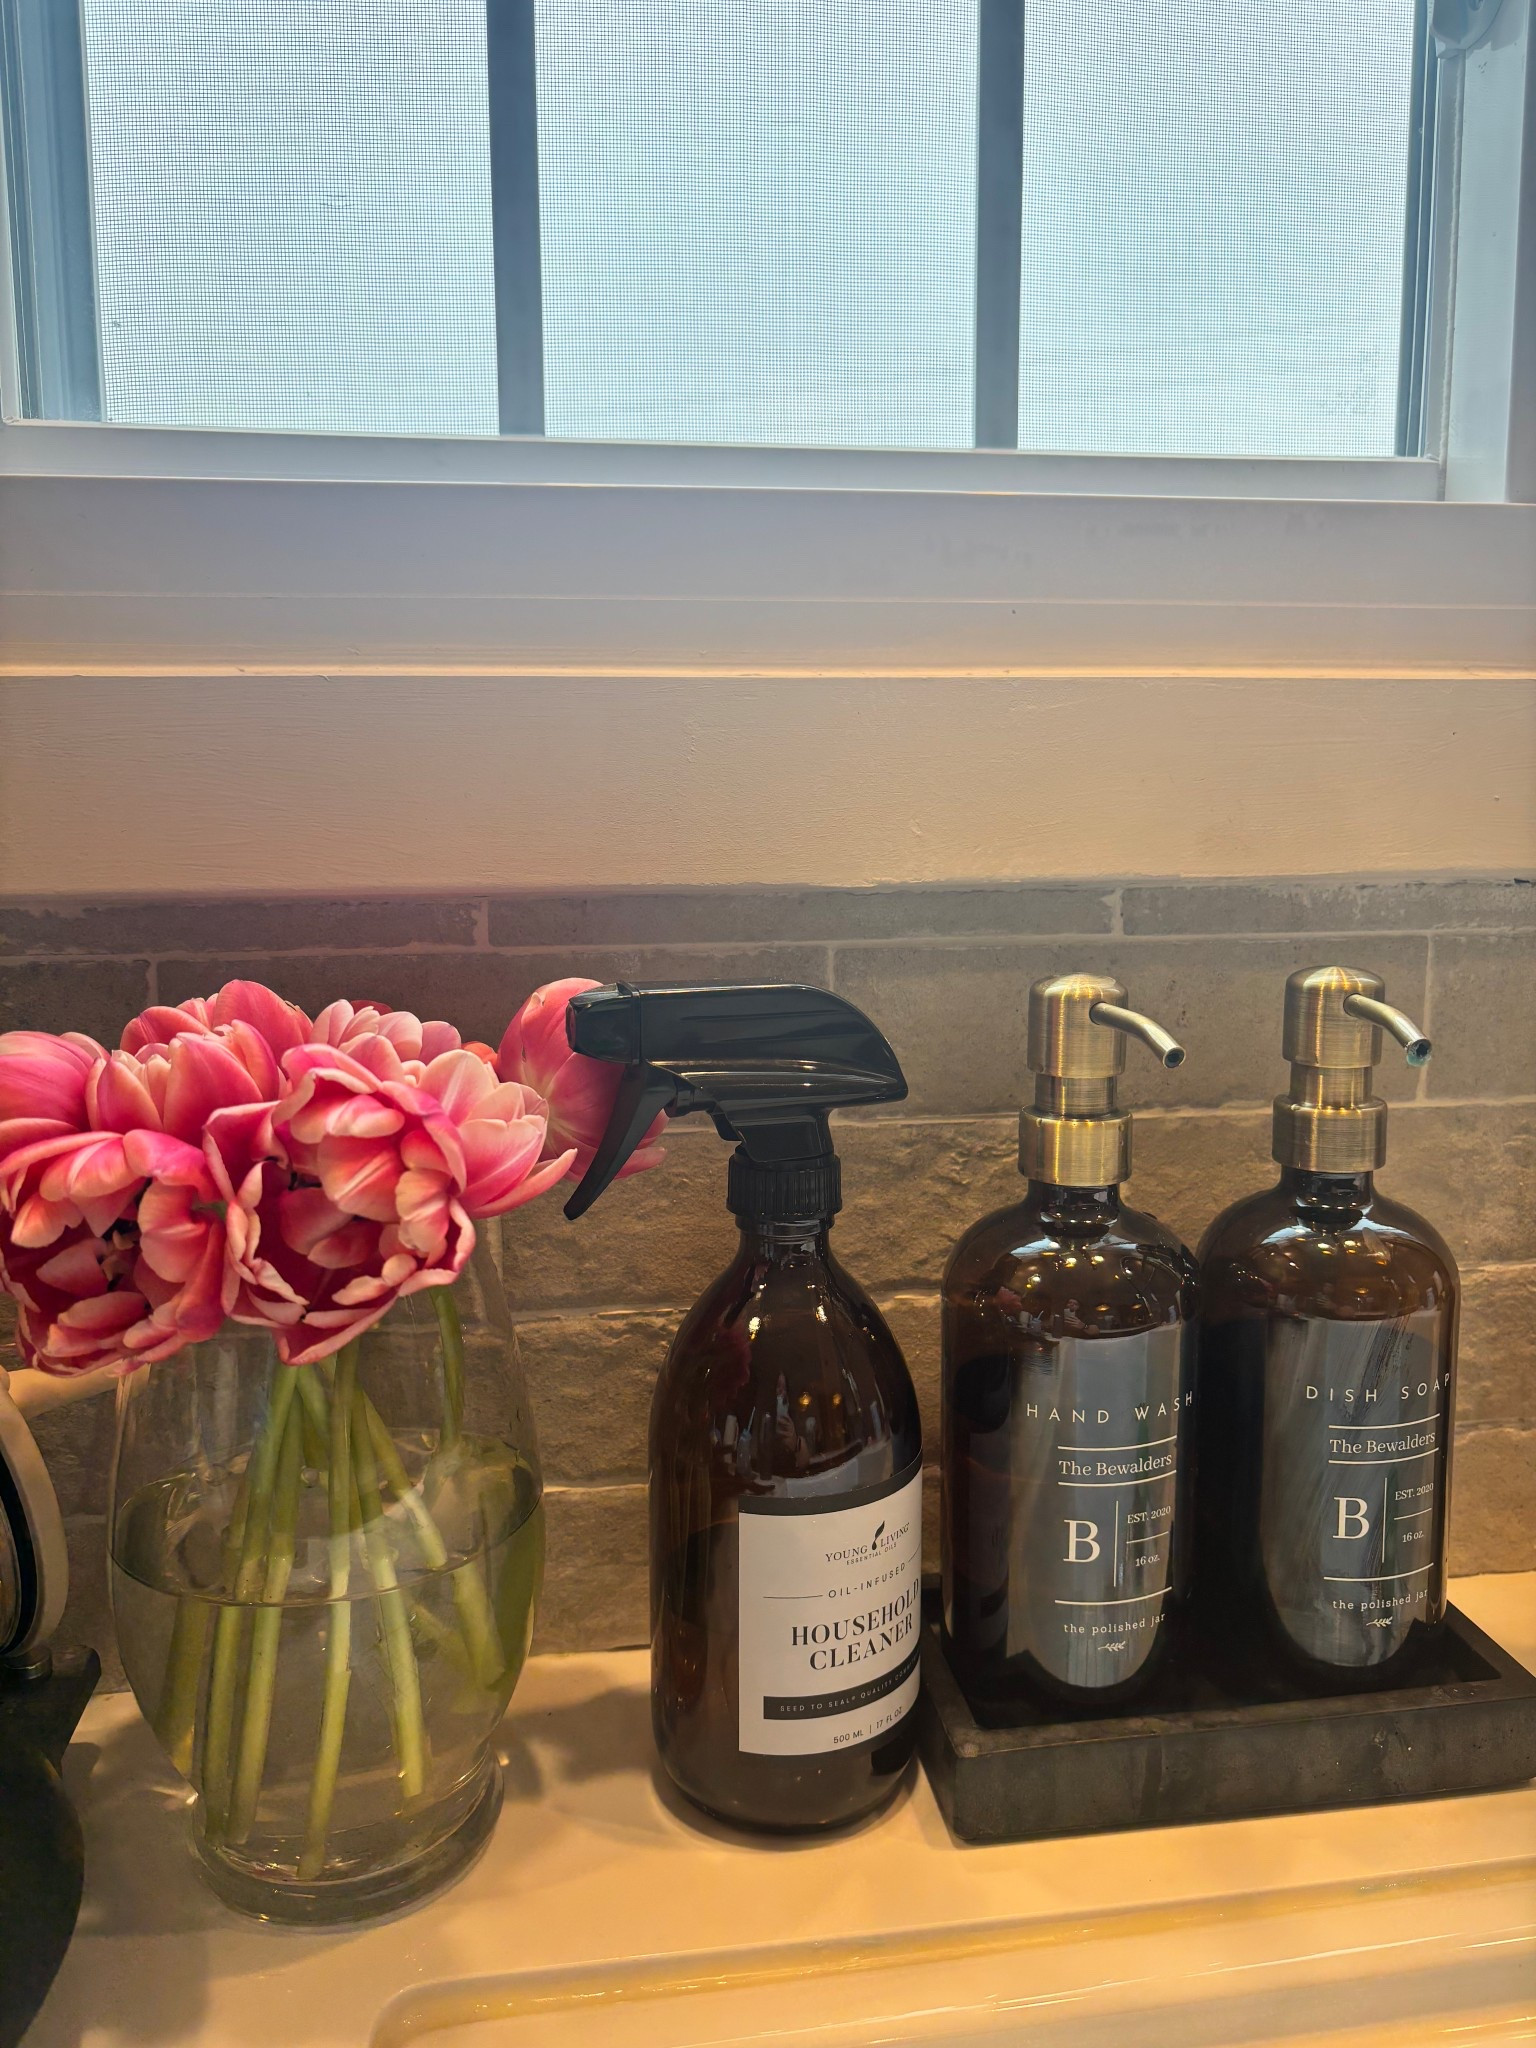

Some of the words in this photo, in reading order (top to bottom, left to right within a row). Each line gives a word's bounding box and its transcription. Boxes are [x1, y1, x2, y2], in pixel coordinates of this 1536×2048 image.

[1306, 1385, 1377, 1402] DISH
[1401, 1373, 1450, 1400] SOAP
[1026, 1403, 1110, 1424] HAND
[1134, 1391, 1193, 1421] WASH
[1329, 1438, 1362, 1454] The
[1365, 1430, 1436, 1454] Bewalders
[1058, 1460, 1092, 1476] The
[1095, 1454, 1173, 1476] Bewalders
[1394, 1489, 1416, 1501] EST.
[1416, 1482, 1434, 1497] 2020
[1127, 1513, 1150, 1525] EST.
[1150, 1504, 1171, 1521] 2020
[1332, 1496, 1370, 1540] B
[1062, 1519, 1101, 1563] B
[1402, 1532, 1413, 1543] 16
[825, 1544, 868, 1563] YOUNG
[846, 1551, 882, 1565] ESSENTIAL
[884, 1541, 897, 1553] OILS
[1135, 1554, 1146, 1567] 16
[828, 1562, 906, 1599] OIL-INFUSED
[791, 1578, 920, 1646] HOUSEHOLD
[1332, 1599, 1354, 1610] the
[1360, 1594, 1412, 1612] polished
[1414, 1589, 1428, 1605] jar
[1063, 1623, 1085, 1634] the
[1091, 1617, 1146, 1636] polished
[1150, 1612, 1166, 1628] jar
[809, 1612, 913, 1671] CLEANER
[780, 1704, 805, 1712] SEED
[811, 1702, 823, 1710] TO
[833, 1733, 850, 1744] 500
[852, 1730, 864, 1739] ML
[876, 1719, 884, 1729] 17
[886, 1715, 893, 1723] FL
